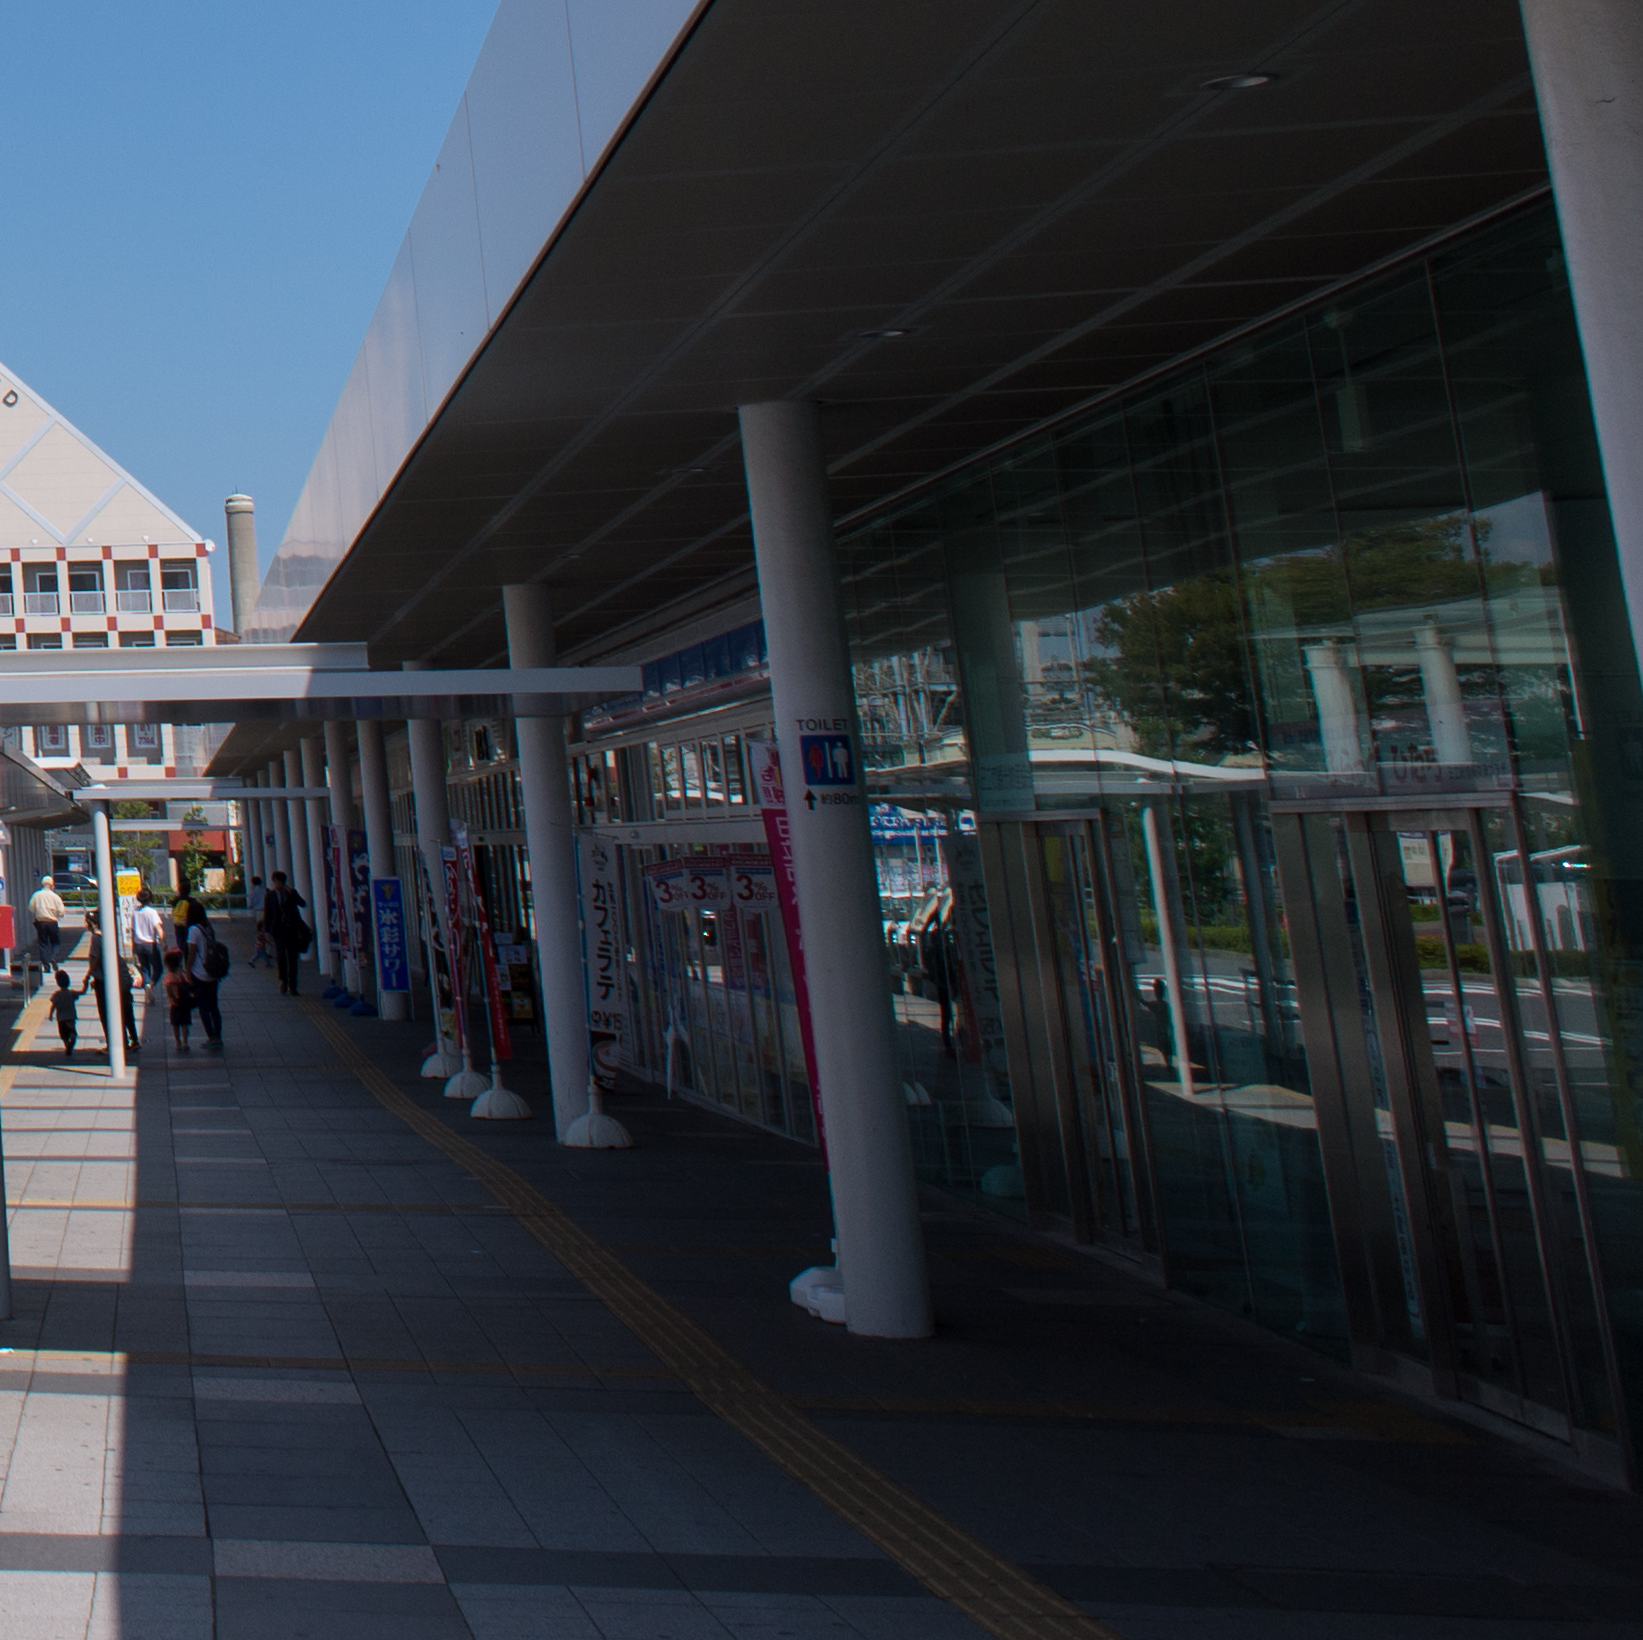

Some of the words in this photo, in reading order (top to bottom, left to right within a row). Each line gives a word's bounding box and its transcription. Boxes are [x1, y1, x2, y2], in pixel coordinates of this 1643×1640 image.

[796, 718, 848, 732] TOILET
[754, 891, 775, 901] OFF
[592, 882, 615, 1001] カフェラテ
